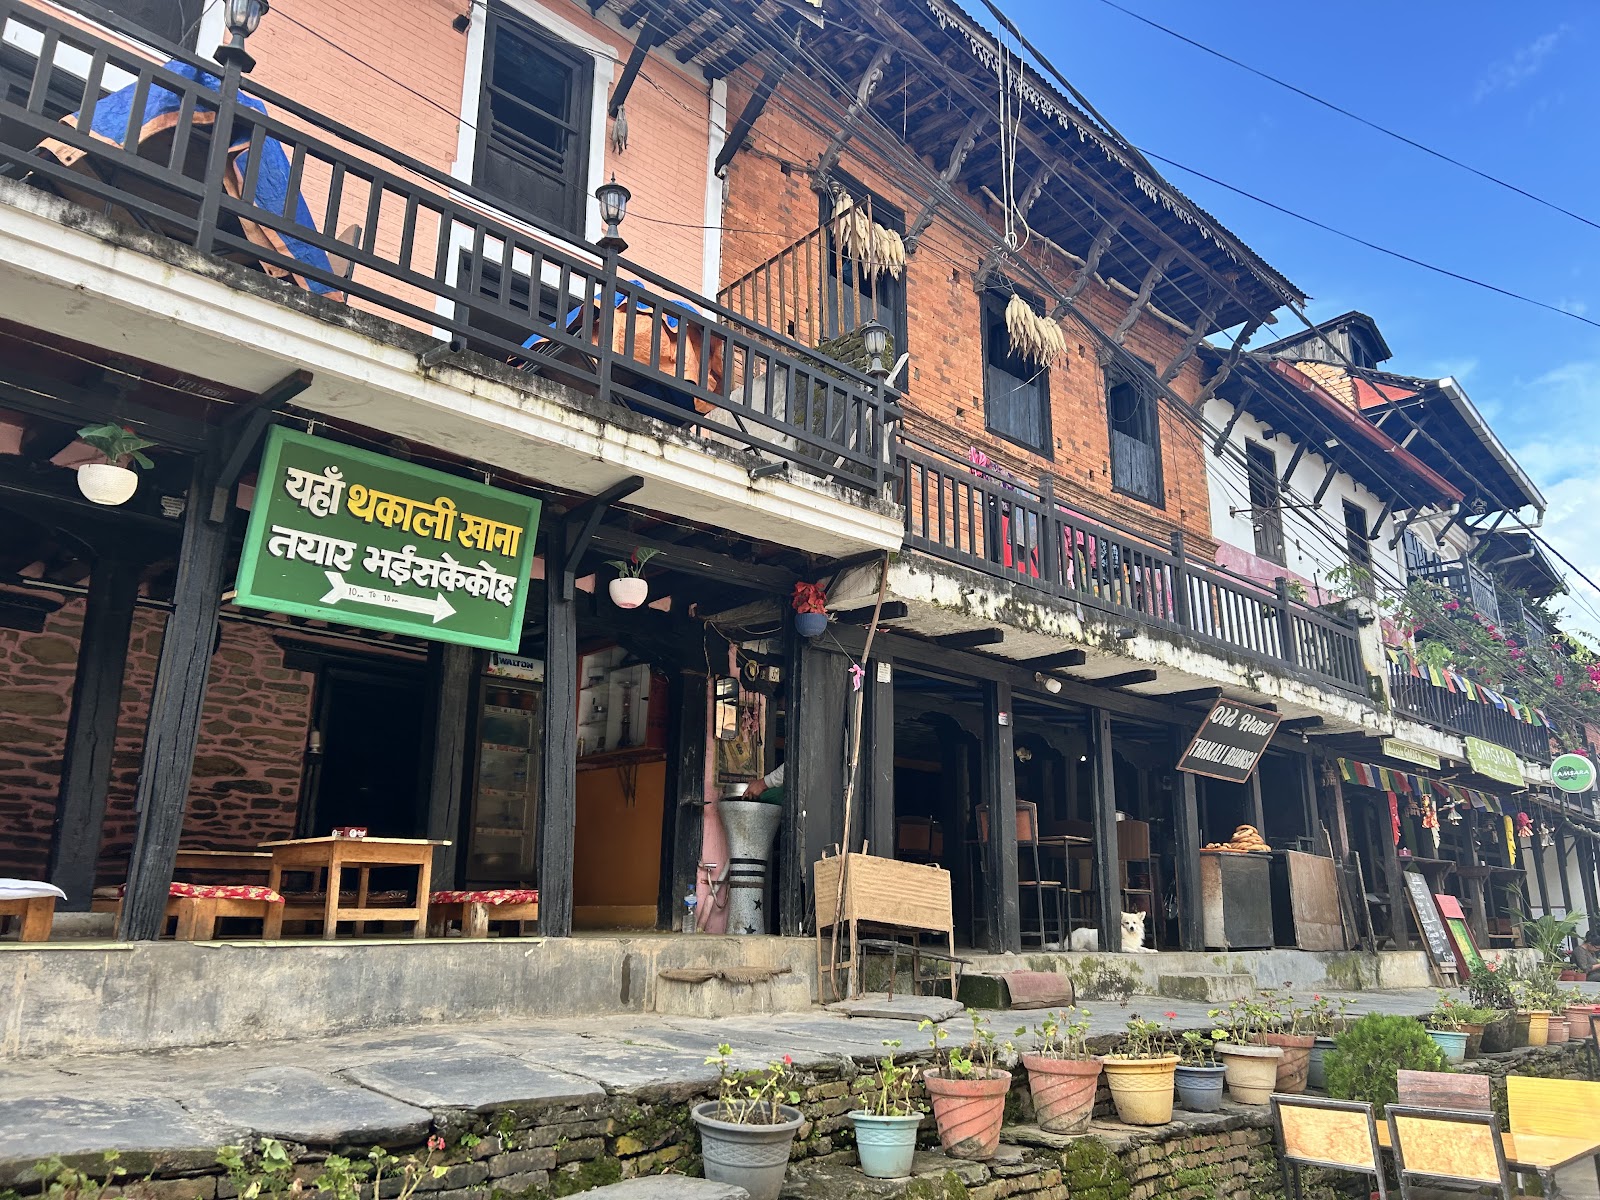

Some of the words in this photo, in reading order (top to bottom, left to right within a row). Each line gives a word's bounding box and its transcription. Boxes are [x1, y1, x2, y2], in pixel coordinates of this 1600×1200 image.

[285, 465, 346, 517] यहाँ
[347, 482, 458, 541] थकाली
[458, 512, 523, 557] खाना
[268, 524, 357, 571] तयार
[499, 657, 533, 669] WALTON
[1210, 705, 1240, 728] Old
[1238, 713, 1275, 736] Home
[1188, 737, 1230, 763] THAKALI
[1221, 746, 1258, 770] BHANSA
[1475, 741, 1514, 769] SAMSARA
[1553, 769, 1590, 777] SAMSARA
